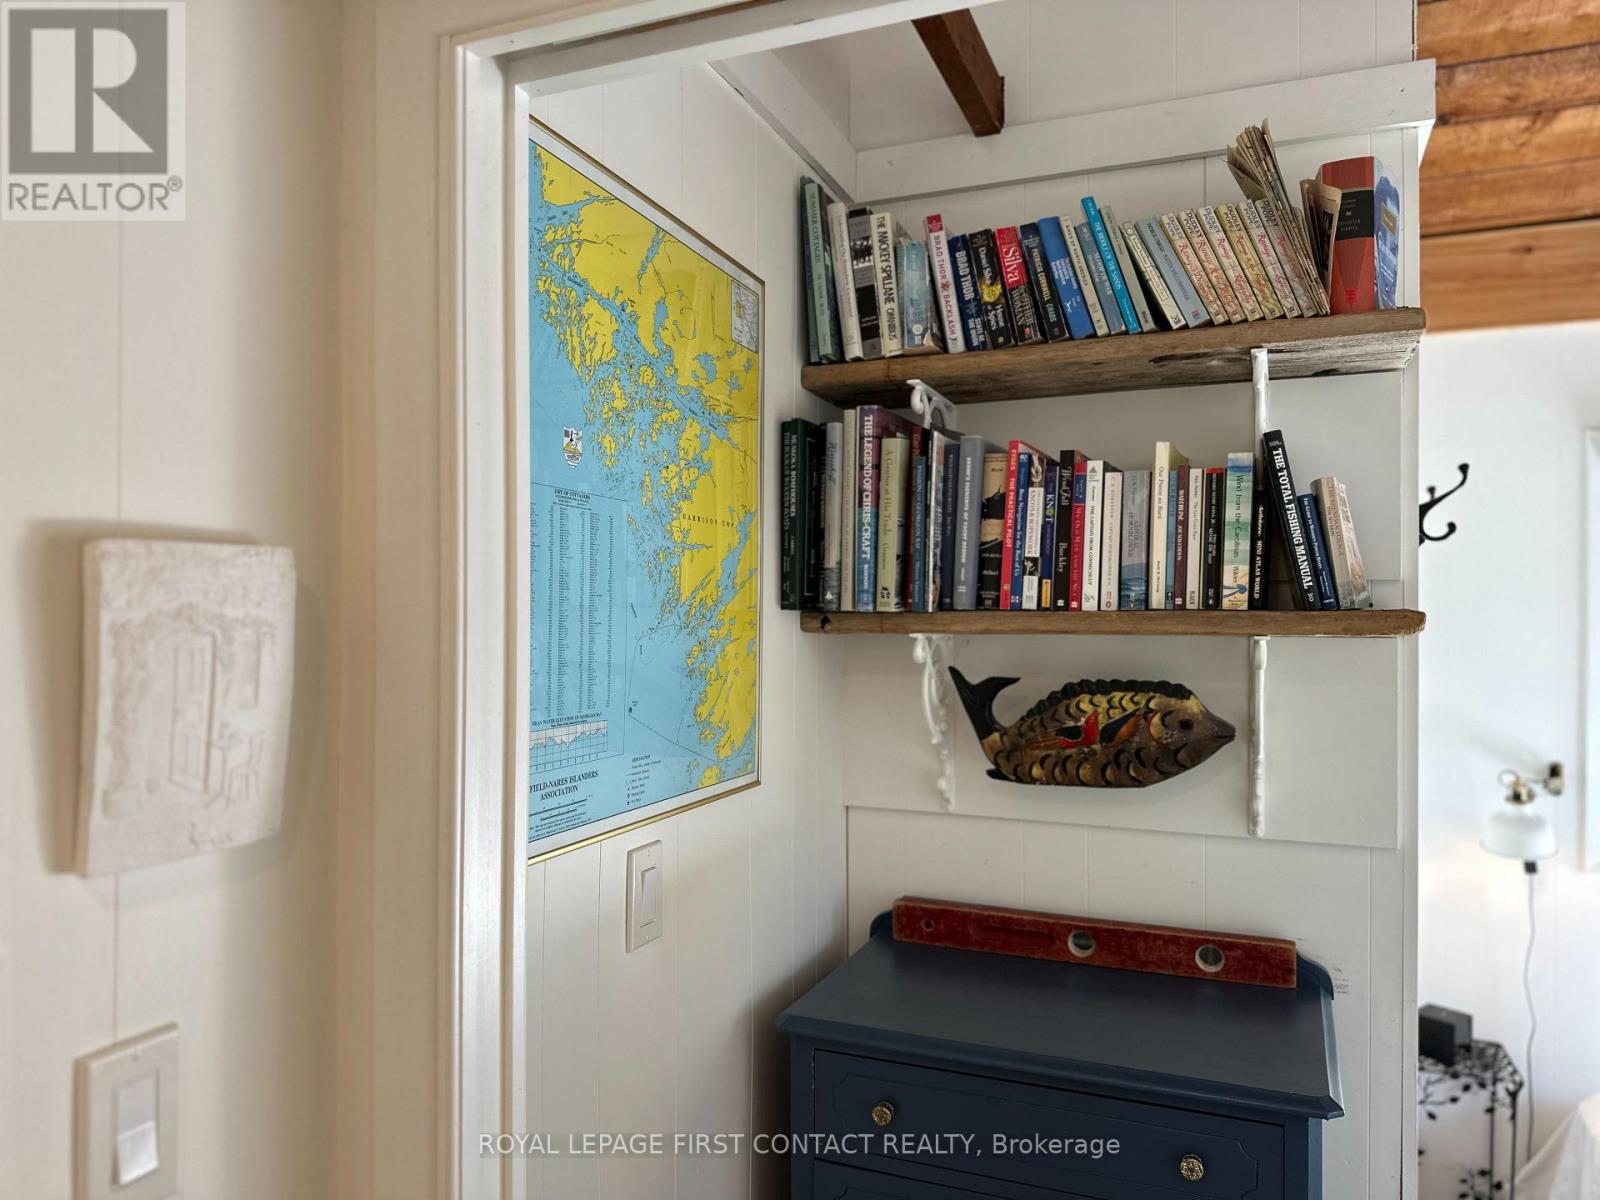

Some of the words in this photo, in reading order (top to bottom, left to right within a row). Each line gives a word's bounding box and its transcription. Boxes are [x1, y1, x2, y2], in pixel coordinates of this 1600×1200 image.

[876, 216, 886, 229] THE
[1186, 212, 1203, 239] DUDLEY
[1203, 213, 1214, 231] POPE
[1205, 207, 1222, 234] DUDLEY
[1223, 211, 1235, 229] POPE
[1226, 206, 1243, 233] DUDLEY
[1243, 207, 1254, 225] POPE
[1246, 202, 1262, 230] DUDLEY
[1260, 205, 1272, 224] POPE
[1263, 200, 1279, 228] DUDLEY
[1165, 221, 1176, 237] POPE
[1168, 215, 1184, 240] DUDLEY
[1183, 217, 1195, 235] POPE
[813, 227, 824, 264] COTTAGES
[878, 231, 891, 263] MICKEY
[934, 235, 944, 257] BRAD
[937, 258, 947, 280] THOR
[956, 250, 970, 275] BRAD
[978, 247, 990, 268] Daniel
[1002, 246, 1026, 284] Silva
[881, 264, 895, 305] SPILLANE
[960, 275, 975, 301] THOR
[982, 268, 993, 285] Silva
[1031, 248, 1044, 274] PATRICIA
[1046, 303, 1057, 323] CHAOS
[886, 307, 898, 341] OMNIBUS
[943, 294, 956, 336] BACKLASH
[988, 311, 999, 331] Spies
[994, 304, 1006, 328] House
[864, 415, 873, 437] THE
[863, 437, 873, 477] LEGEND
[885, 449, 894, 457] A
[1271, 448, 1286, 470] THE
[863, 478, 872, 492] OF
[1236, 474, 1244, 492] Wind
[1277, 469, 1294, 503] TOTAL
[1326, 486, 1335, 499] THE
[1158, 497, 1164, 505] au
[1235, 494, 1243, 511] from
[861, 493, 871, 560] CHRIS-CRAFT
[1235, 512, 1243, 525] the
[1285, 503, 1304, 545] FISHING
[1027, 518, 1035, 555] ROPEWORK
[1233, 526, 1242, 559] Carolinas
[1057, 542, 1067, 573] Buckley
[1294, 544, 1314, 589] MANUAL
[1232, 566, 1240, 583] Wilder
[569, 769, 600, 784] ISLANDERS
[540, 785, 579, 801] ASSOCIATION
